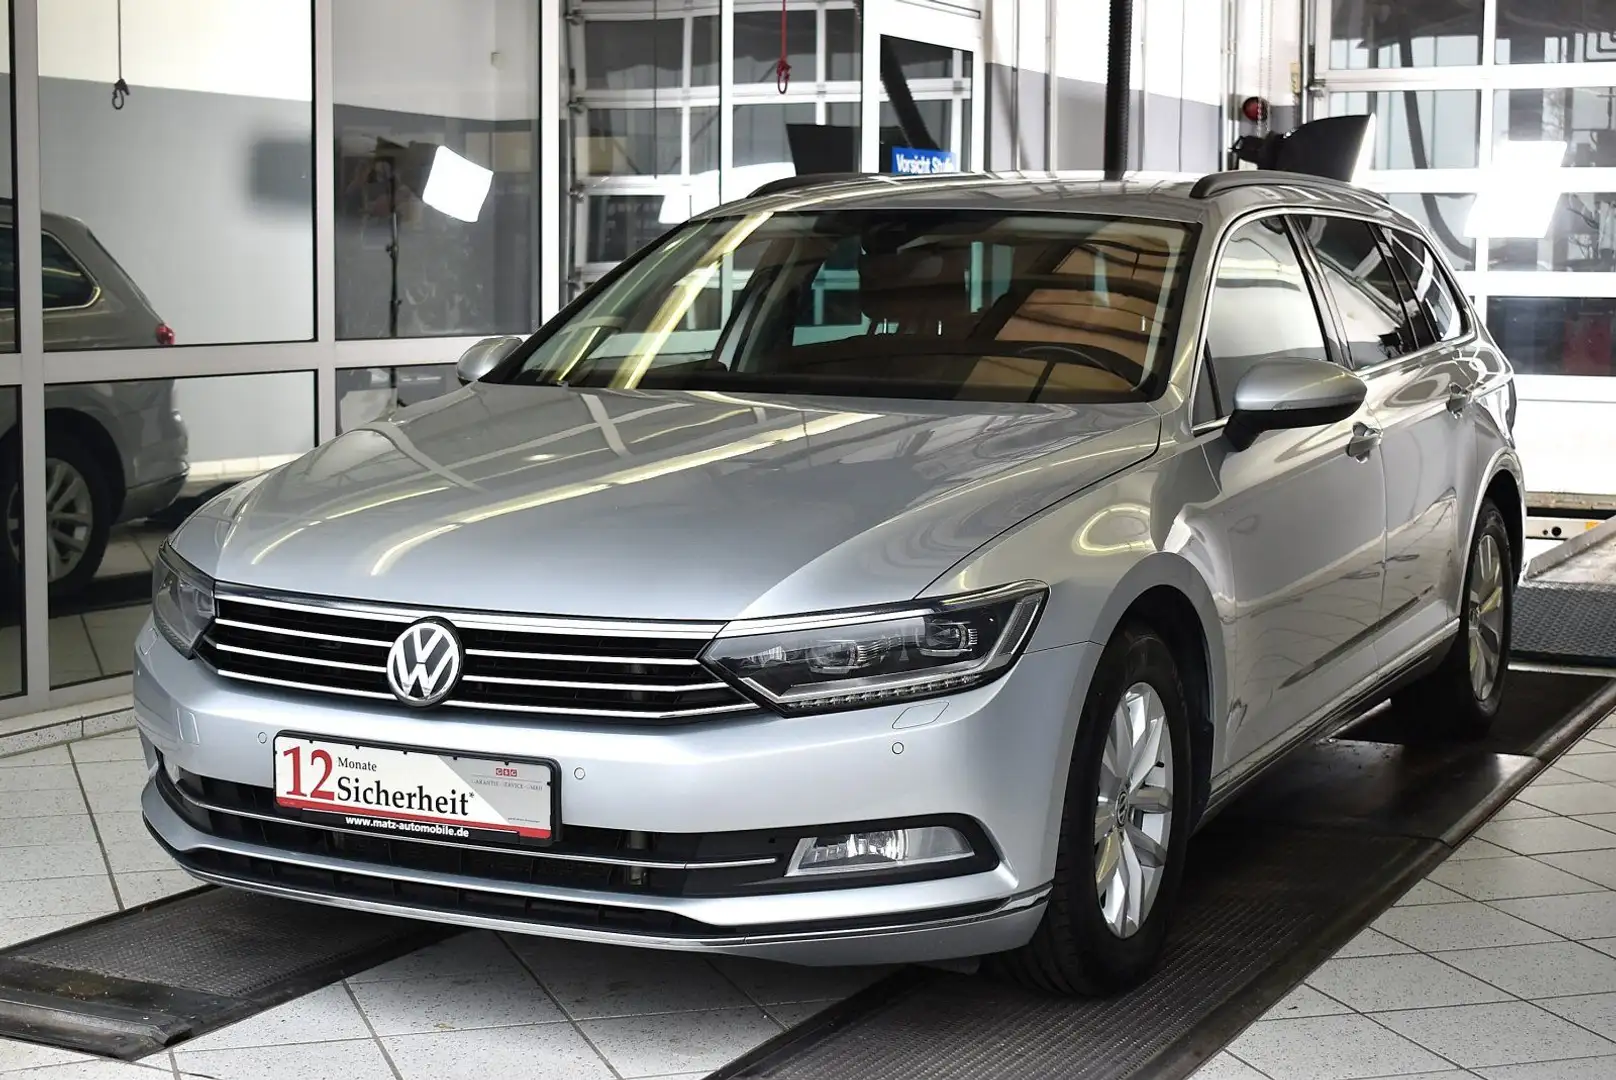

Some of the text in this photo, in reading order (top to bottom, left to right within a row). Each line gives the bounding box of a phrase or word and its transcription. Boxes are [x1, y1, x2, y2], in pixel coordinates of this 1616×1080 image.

[896, 153, 931, 174] Vorsicht
[283, 746, 335, 801] 12
[337, 756, 378, 772] Monate
[502, 781, 523, 790] ERVICE
[345, 816, 469, 837] www.matz-automobile.de
